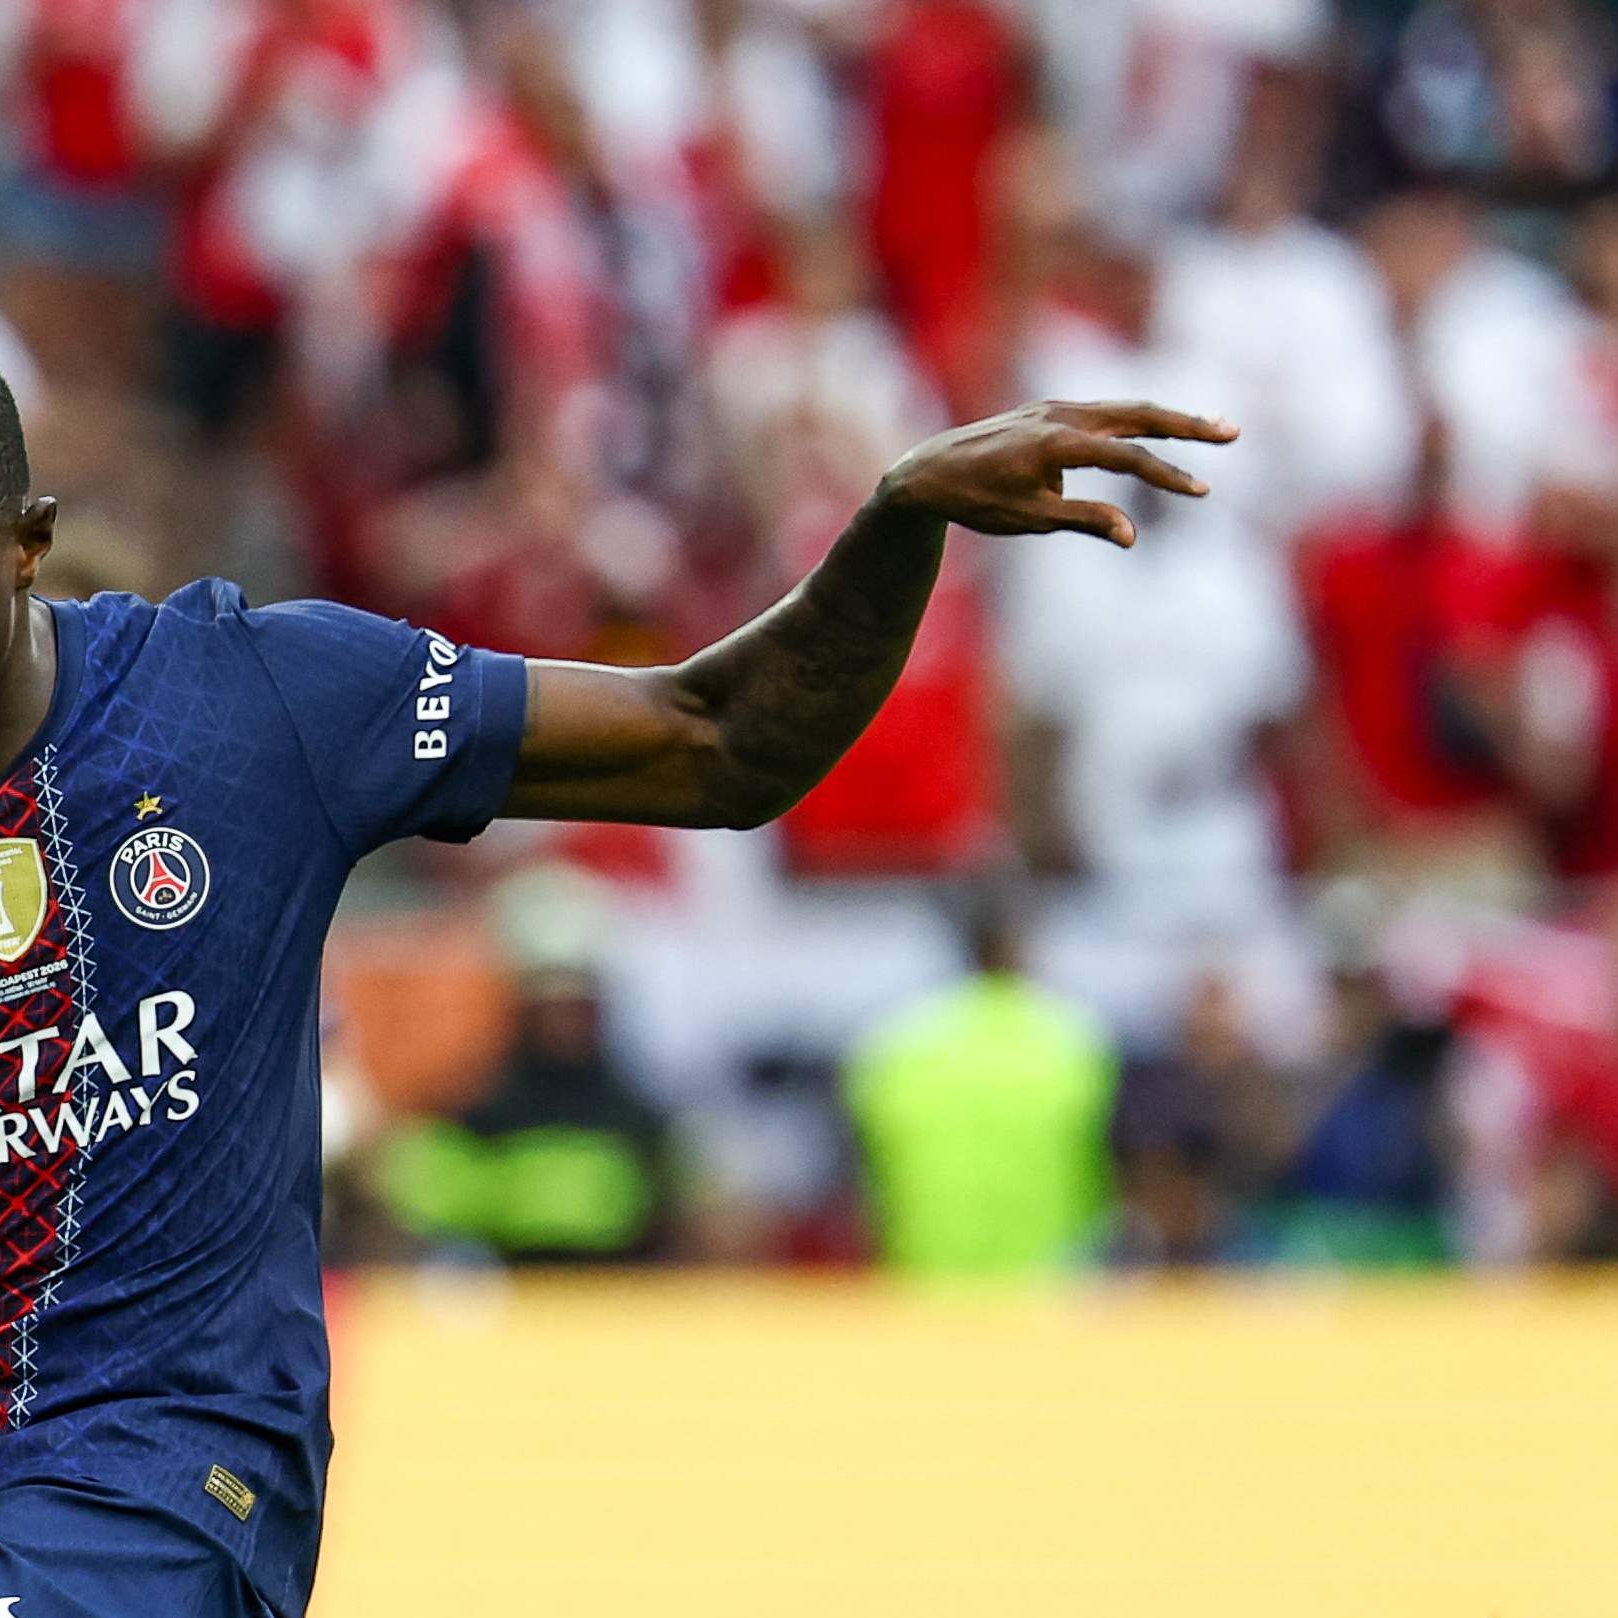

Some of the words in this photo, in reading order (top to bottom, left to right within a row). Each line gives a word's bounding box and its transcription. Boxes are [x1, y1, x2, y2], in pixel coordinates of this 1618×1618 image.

[120, 832, 185, 865] PARIS
[135, 906, 160, 920] SAINT
[166, 891, 198, 919] GERMAIN
[40, 959, 68, 976] 2026
